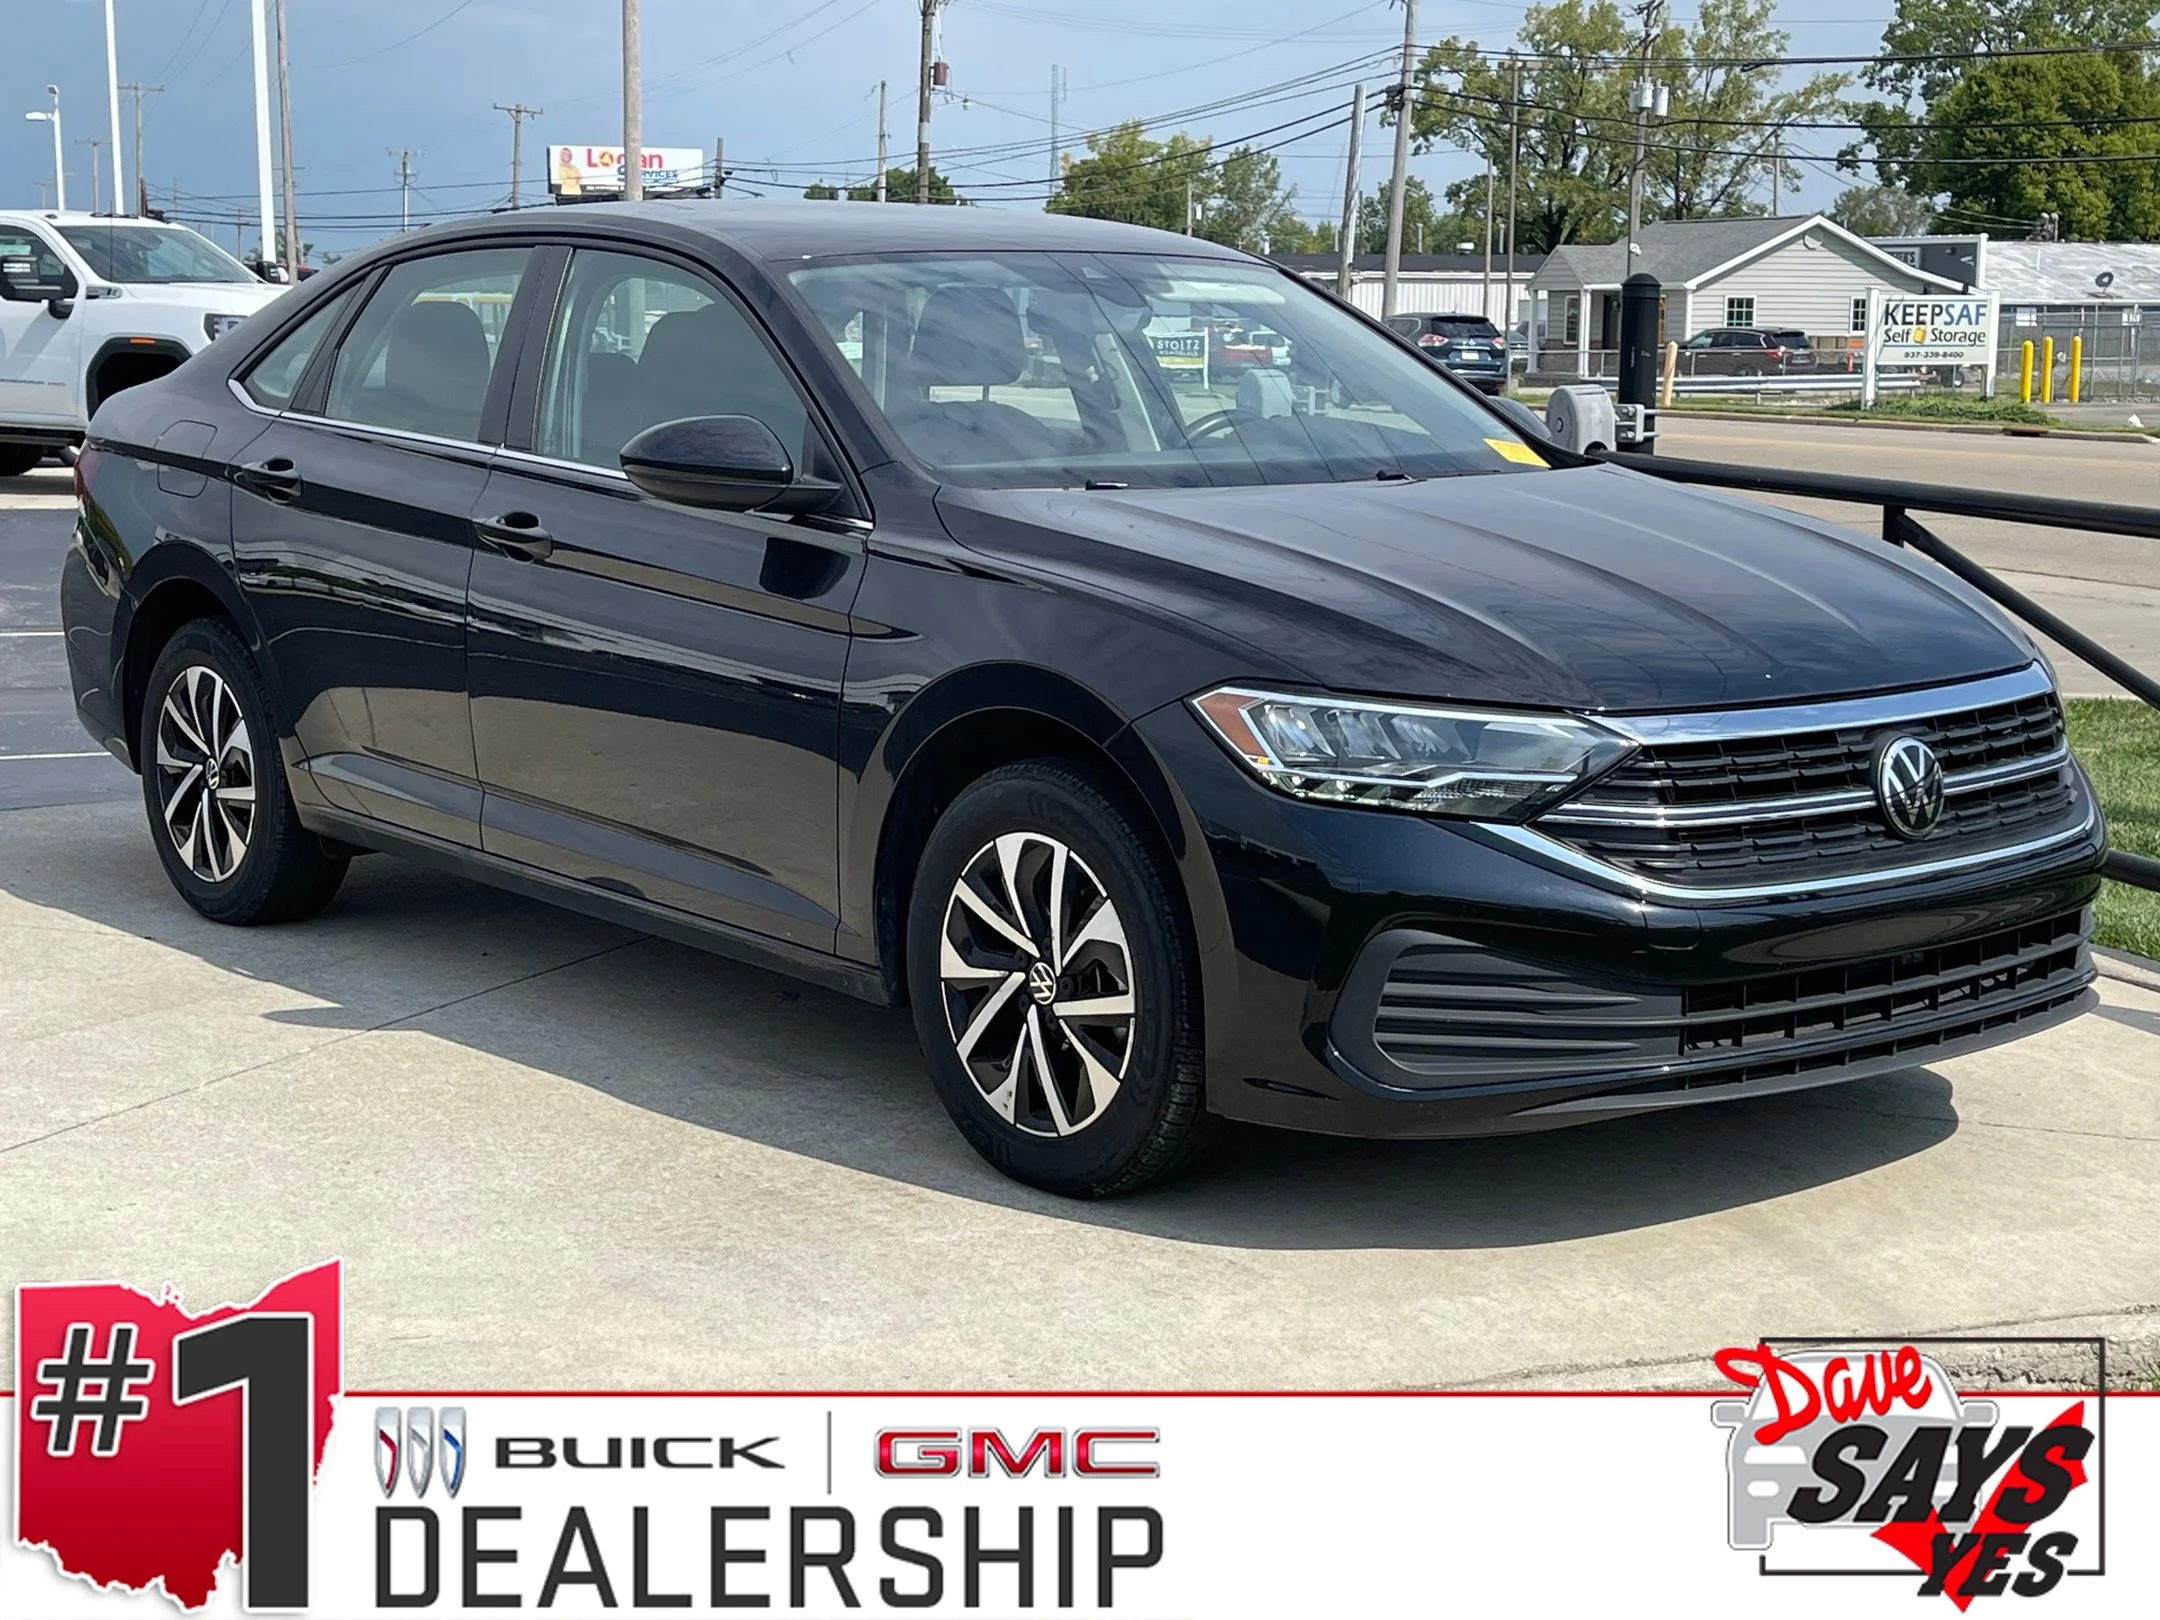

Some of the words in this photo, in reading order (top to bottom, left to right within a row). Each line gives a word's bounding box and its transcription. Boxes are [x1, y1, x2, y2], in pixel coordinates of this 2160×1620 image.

[1884, 303, 1988, 326] KEEPSAF
[1157, 339, 1200, 351] STOLTZ
[1884, 328, 1911, 343] Self
[1930, 327, 1986, 347] Storage
